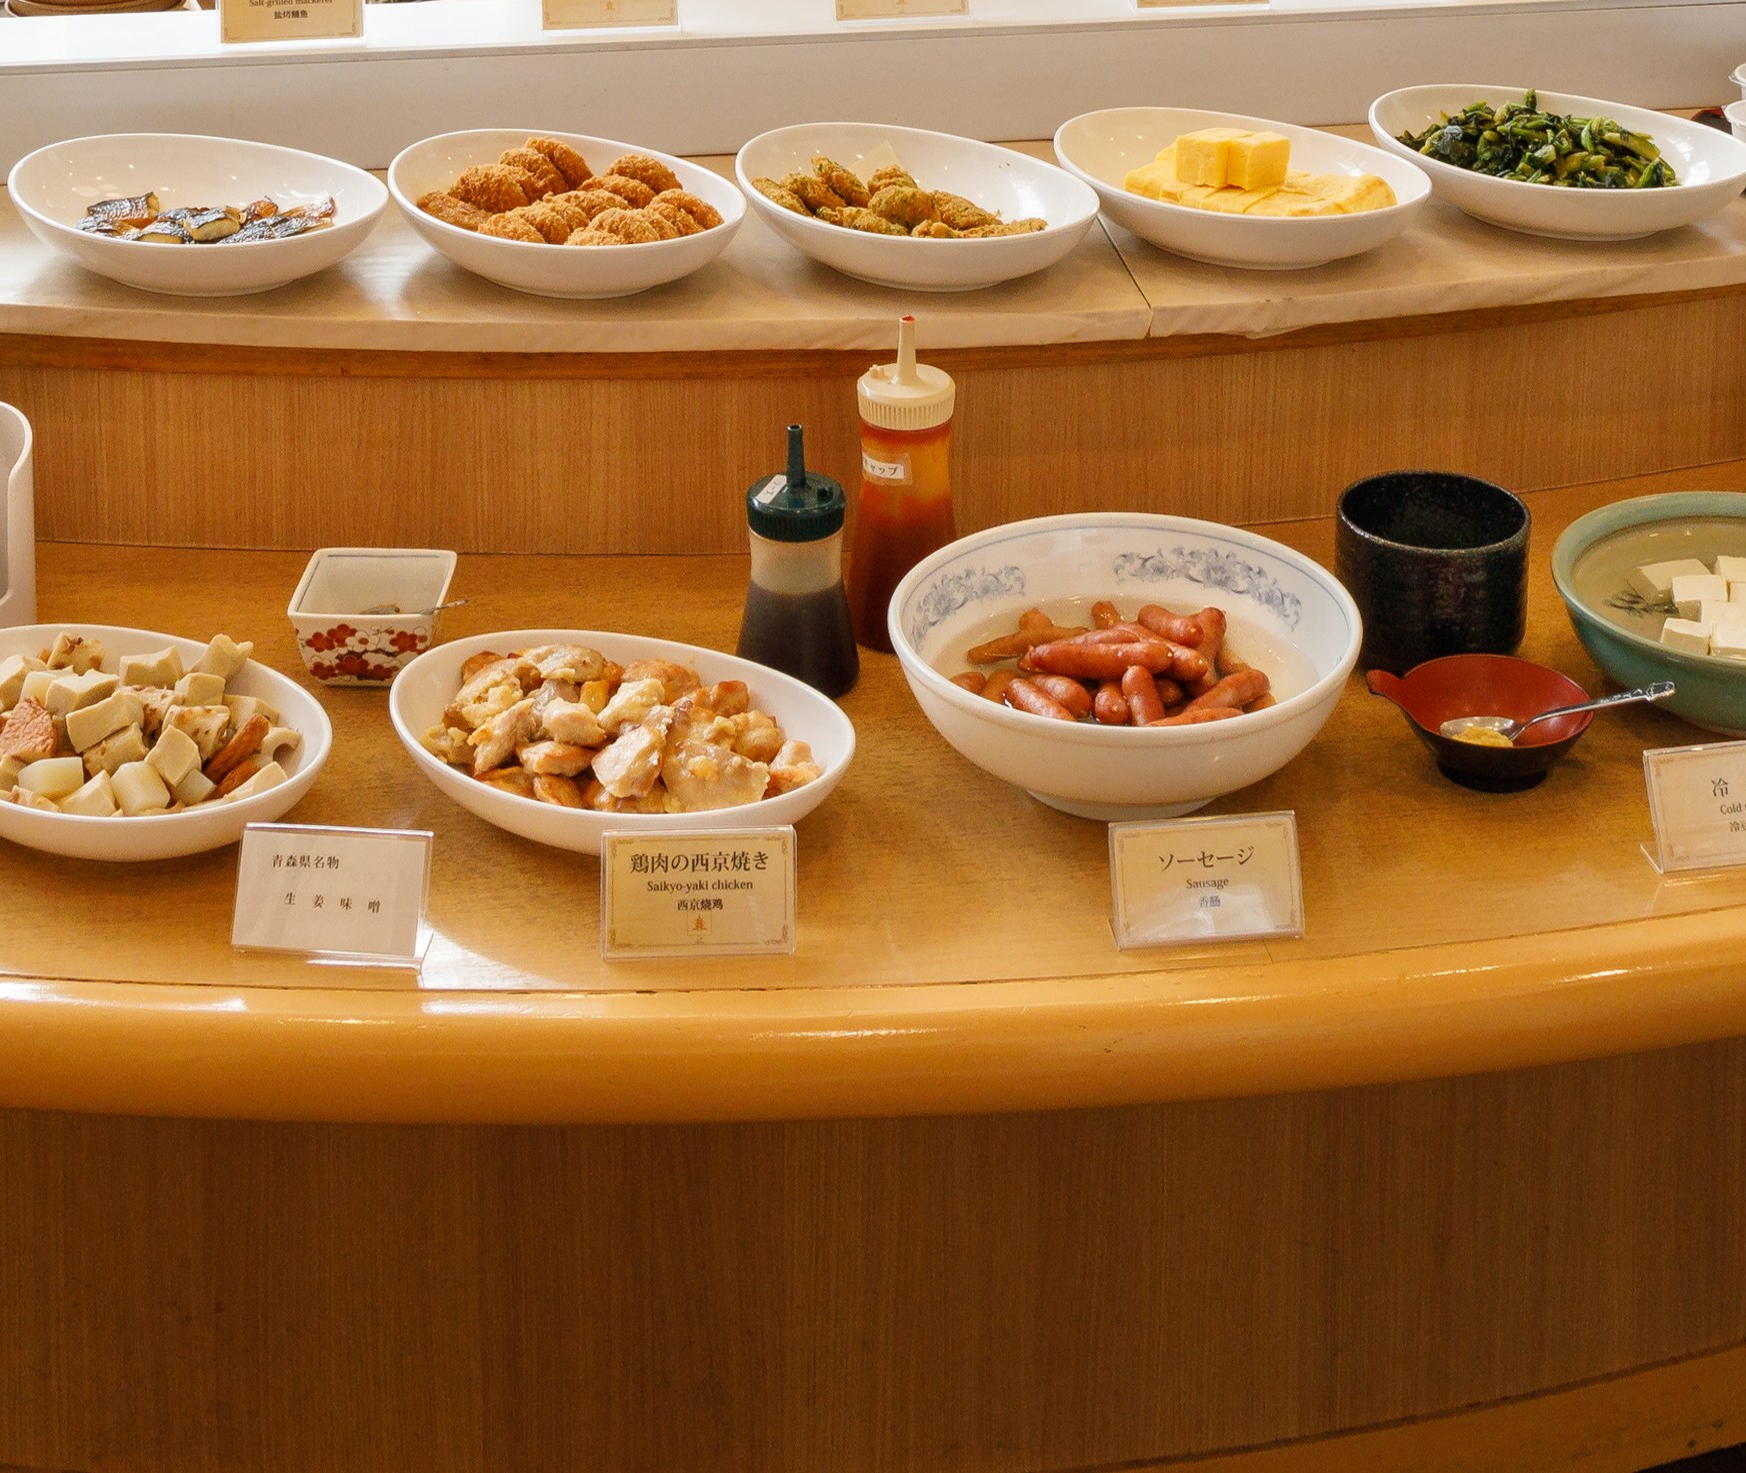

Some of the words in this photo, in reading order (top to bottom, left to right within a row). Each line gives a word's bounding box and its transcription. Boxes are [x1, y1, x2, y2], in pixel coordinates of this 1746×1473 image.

[1720, 803, 1742, 815] Cold
[271, 854, 340, 871] 青森県名物
[630, 851, 770, 874] 鶏肉の西京焼き
[1158, 845, 1254, 872] ソーセージ
[647, 879, 709, 895] Saikyo-yaki
[711, 879, 753, 891] chicken
[1186, 878, 1230, 891] Sausage
